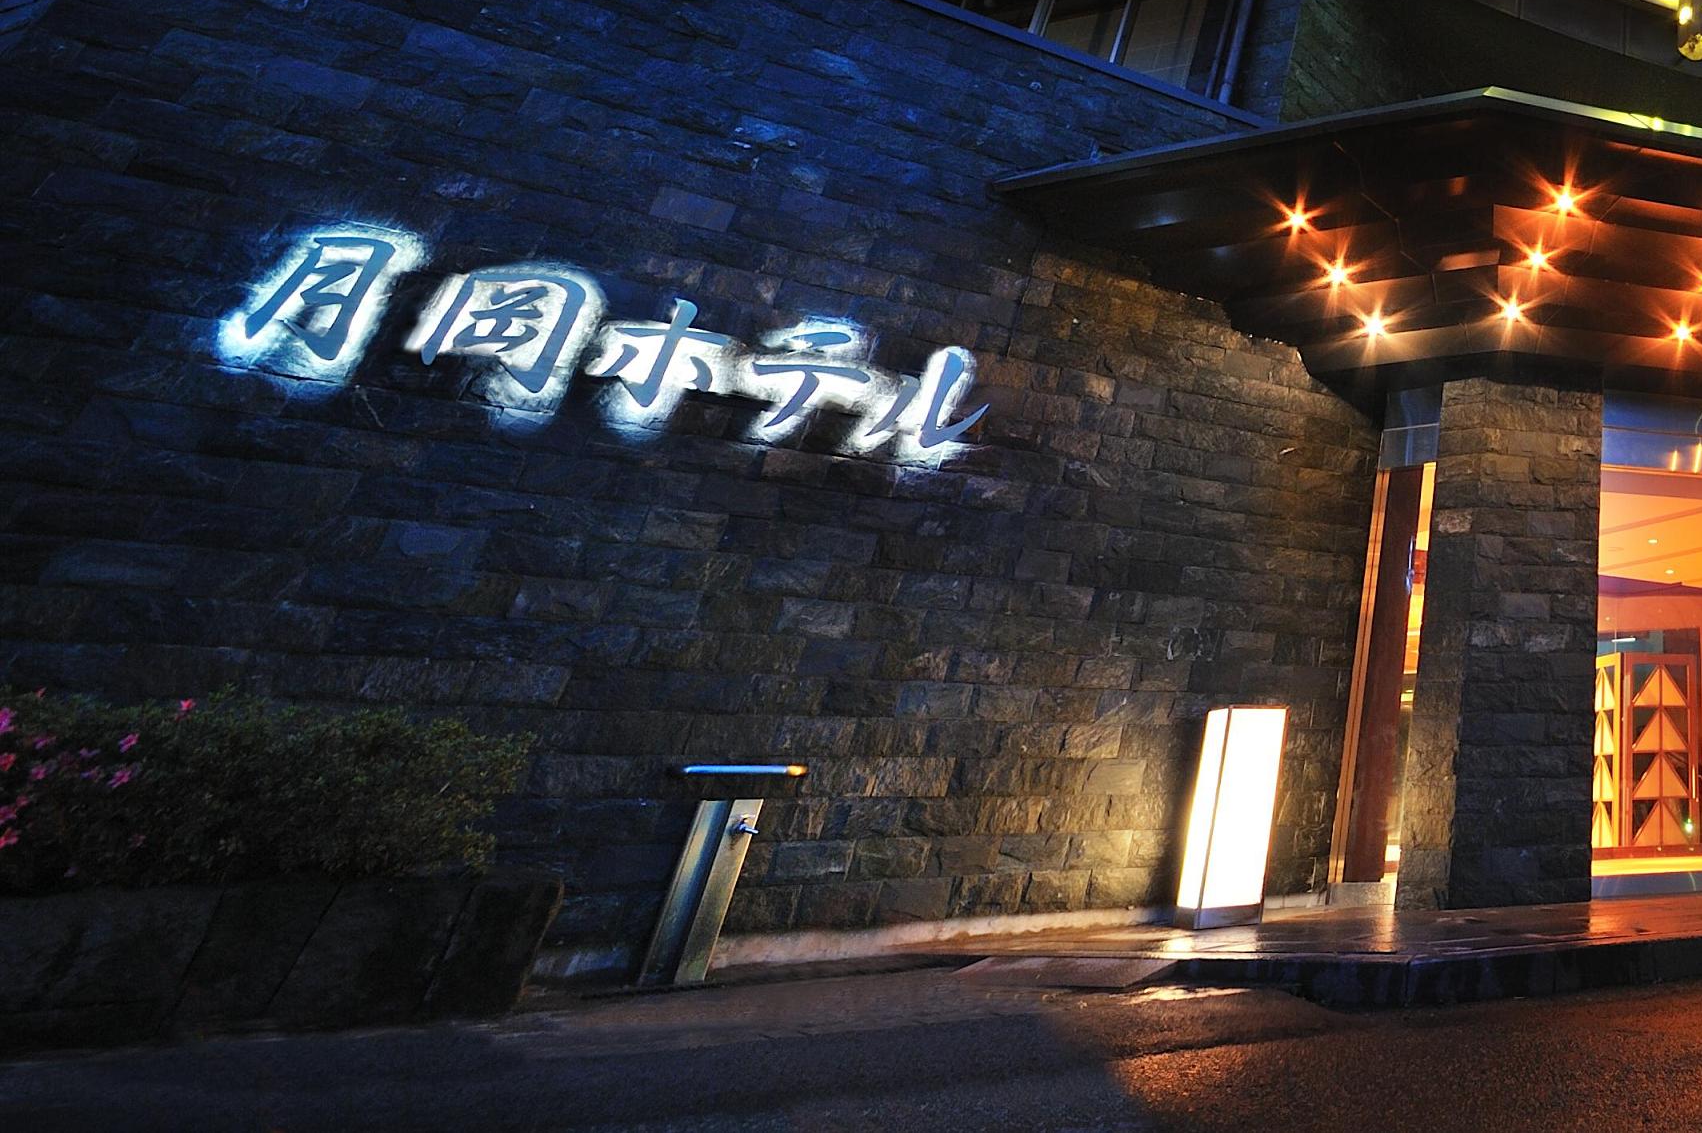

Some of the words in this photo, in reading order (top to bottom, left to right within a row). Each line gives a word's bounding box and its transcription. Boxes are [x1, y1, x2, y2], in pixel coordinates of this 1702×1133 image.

[245, 235, 991, 449] 月岡ホテル
